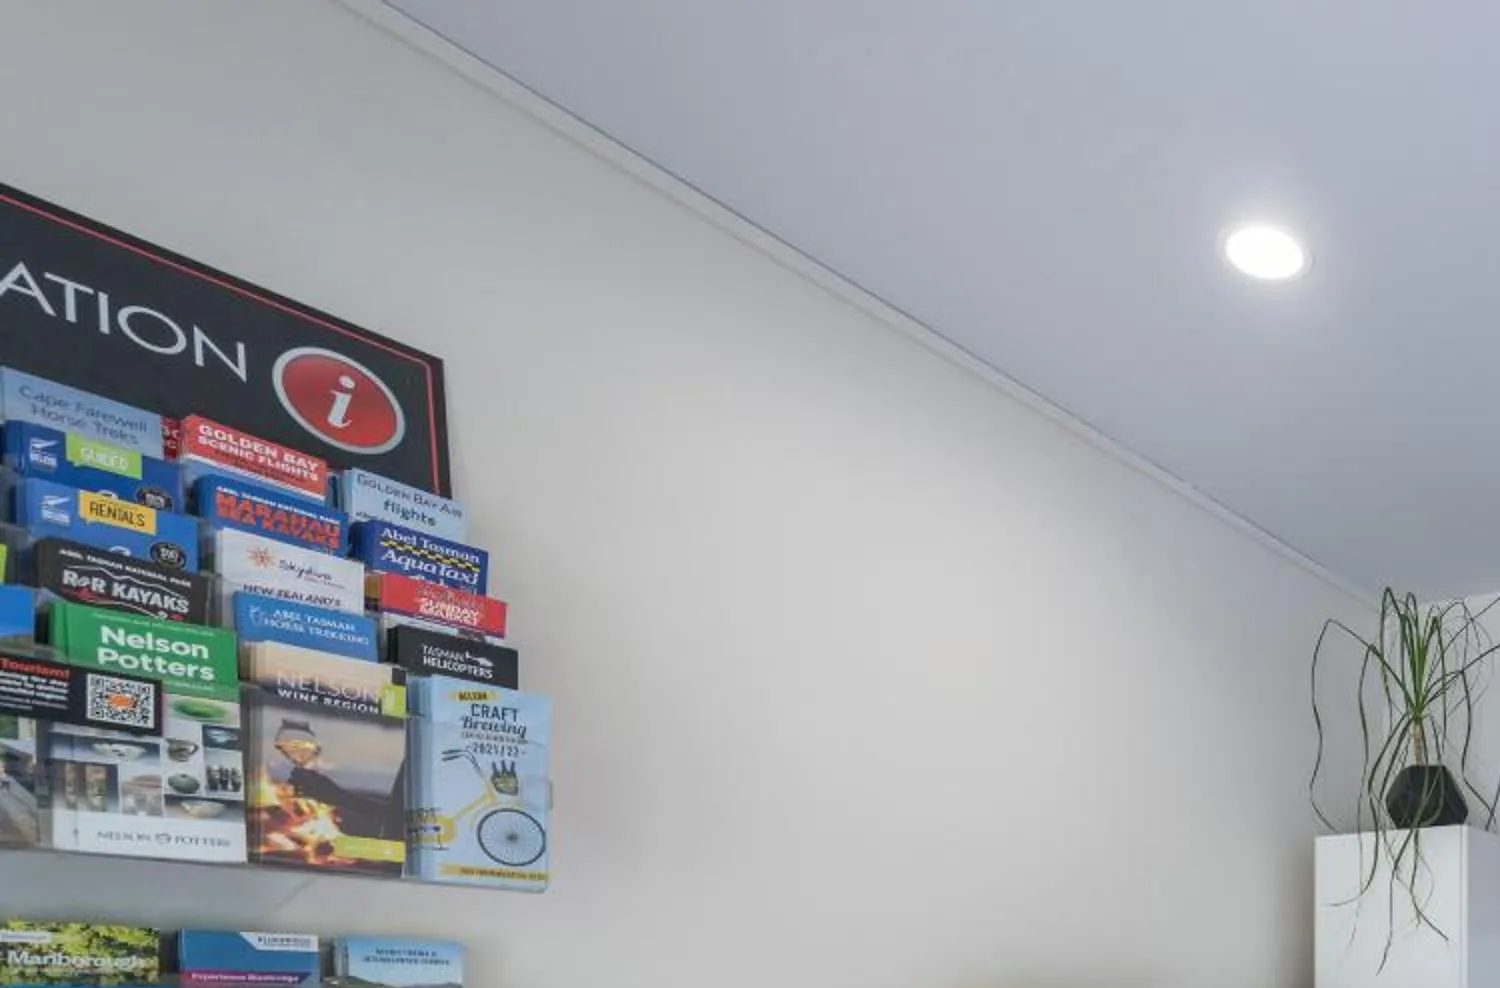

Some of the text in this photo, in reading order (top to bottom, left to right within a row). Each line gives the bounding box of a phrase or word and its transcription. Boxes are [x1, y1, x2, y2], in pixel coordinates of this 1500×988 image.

[19, 386, 147, 433] Cape Farewell
[31, 404, 83, 429] Horse
[96, 423, 139, 446] Treks
[197, 435, 254, 462] SCENIC
[257, 453, 319, 482] FLIGHTS
[198, 424, 277, 458] GOLDEN
[283, 452, 319, 471] BAY
[357, 473, 410, 501] GOLDEN
[89, 501, 145, 527] RENTALS
[384, 499, 436, 527] flights
[382, 527, 480, 563] Abel Tasman
[111, 582, 190, 614] KAYAKS
[100, 625, 209, 660] Nelson
[423, 644, 463, 661] TASMAN
[97, 648, 215, 681] Potters
[423, 656, 493, 678] HELICOPTERS
[277, 670, 380, 703] NELSON
[277, 688, 380, 714] WINE REGION
[460, 715, 527, 739] Brewing
[471, 703, 519, 722] CRAFT
[8, 951, 146, 971] Marlborough
